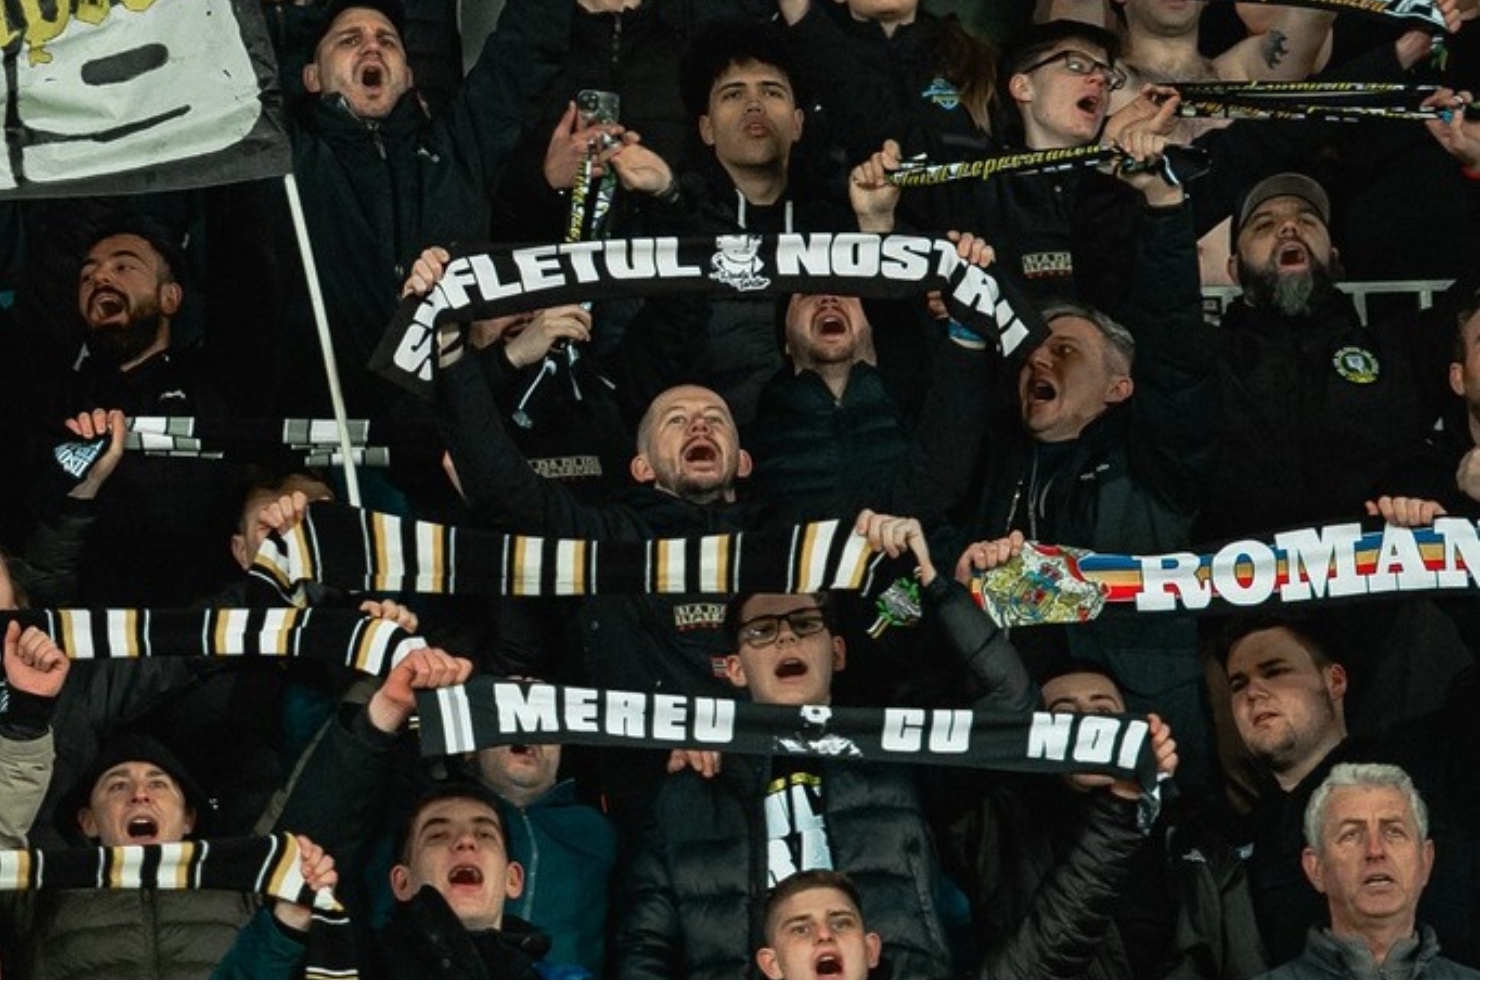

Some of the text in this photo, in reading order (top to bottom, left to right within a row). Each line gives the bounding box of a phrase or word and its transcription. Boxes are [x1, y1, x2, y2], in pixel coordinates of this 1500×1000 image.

[494, 682, 1150, 770] MEREU CU NOI
